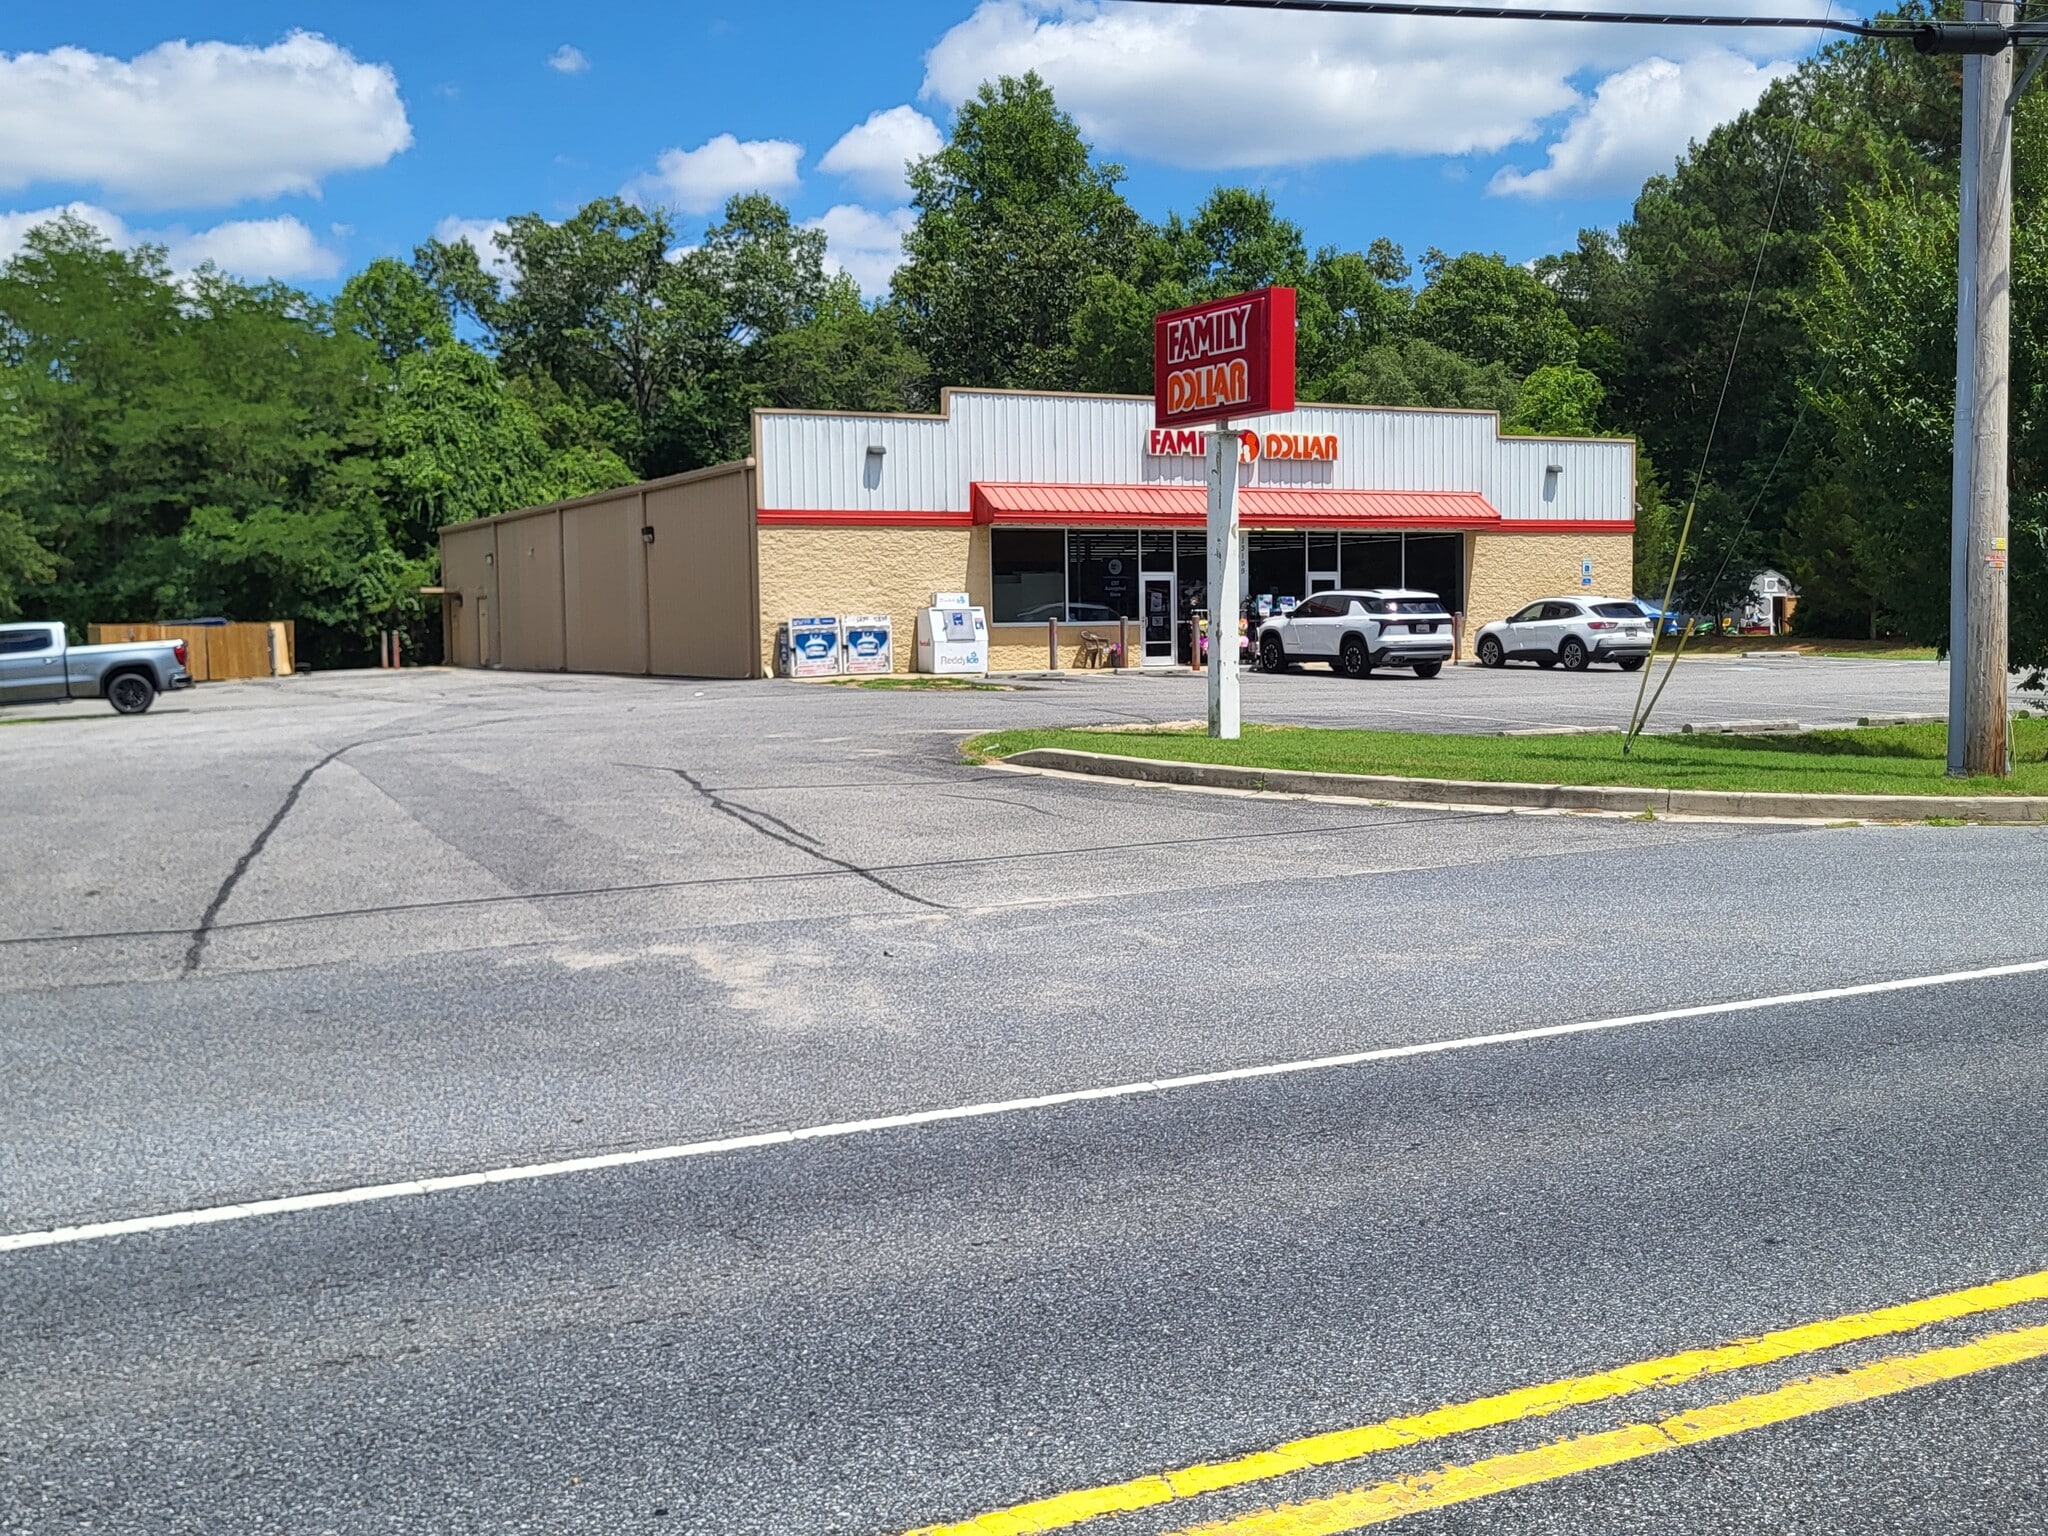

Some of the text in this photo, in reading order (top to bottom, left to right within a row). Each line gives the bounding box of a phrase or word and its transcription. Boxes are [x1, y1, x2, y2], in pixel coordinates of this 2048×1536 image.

[1167, 304, 1252, 364] FAMILY
[1167, 358, 1248, 414] DOLLAR
[1149, 429, 1338, 461] FAMI DOLLAR
